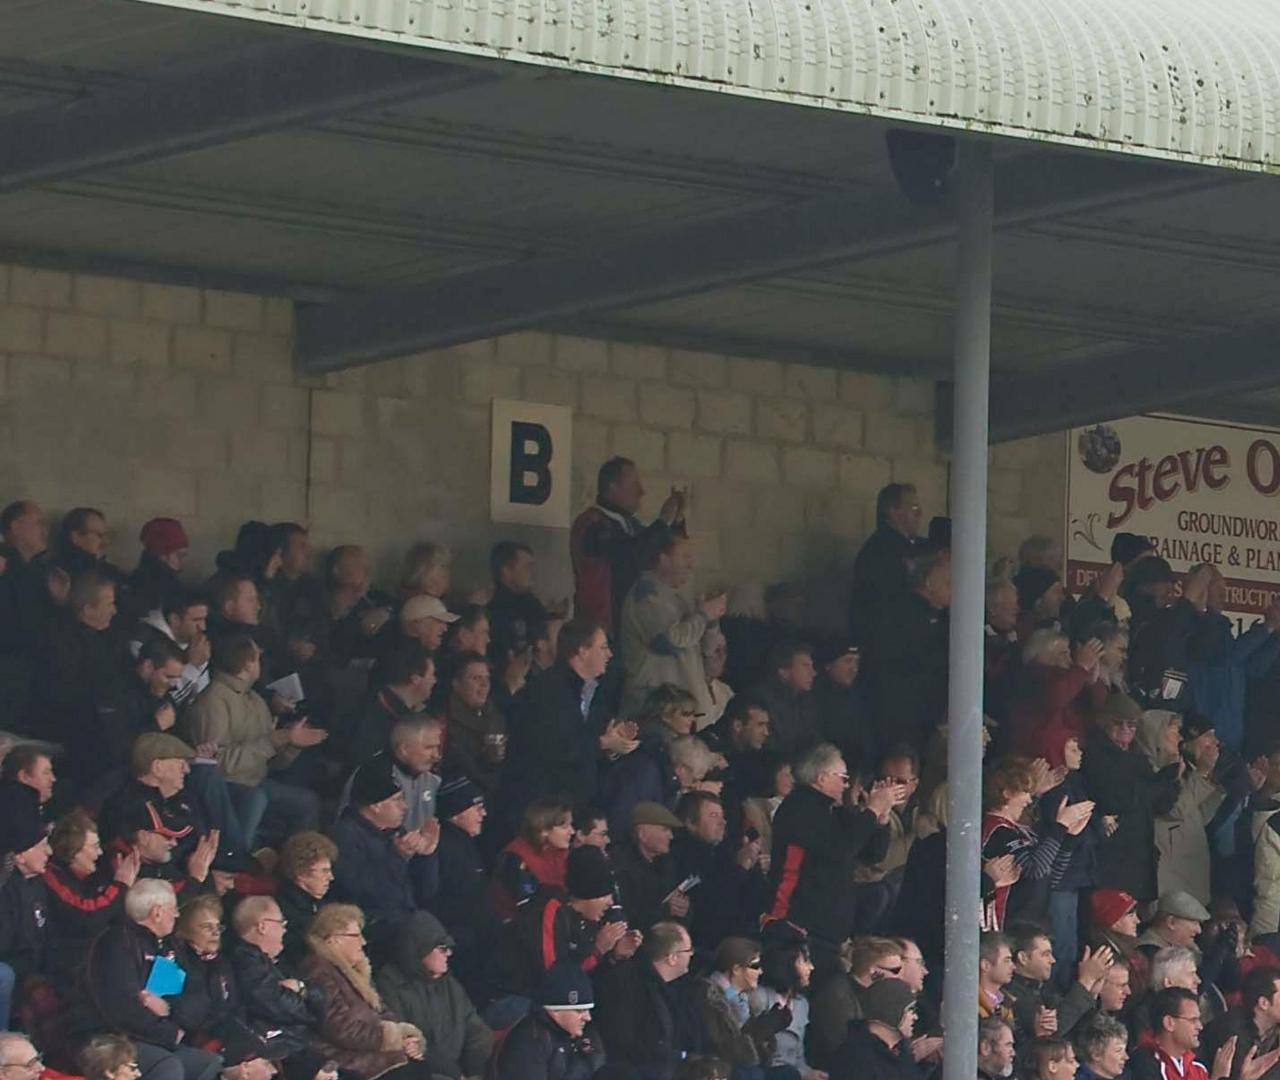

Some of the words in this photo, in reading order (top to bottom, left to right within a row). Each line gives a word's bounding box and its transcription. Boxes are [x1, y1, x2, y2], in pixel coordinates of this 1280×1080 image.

[510, 421, 553, 505] B
[1107, 444, 1229, 529] Steve
[1150, 536, 1223, 565] RAINAGE
[1227, 548, 1240, 566] &
